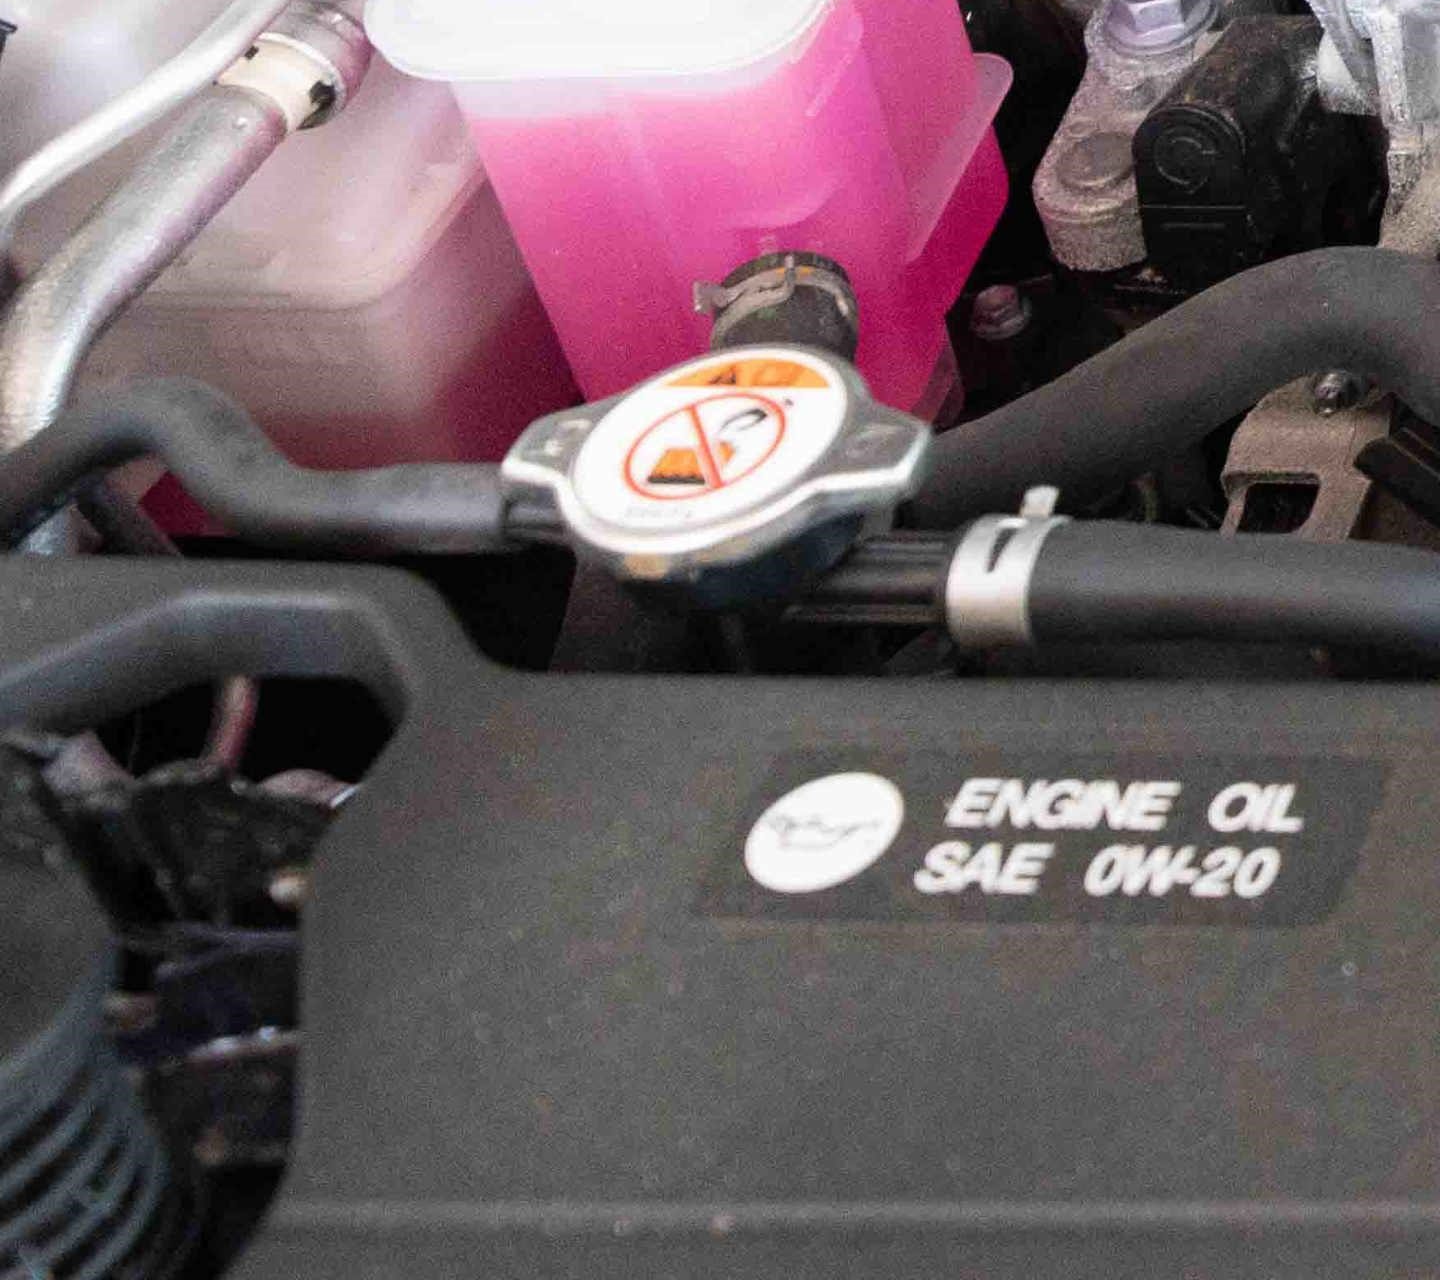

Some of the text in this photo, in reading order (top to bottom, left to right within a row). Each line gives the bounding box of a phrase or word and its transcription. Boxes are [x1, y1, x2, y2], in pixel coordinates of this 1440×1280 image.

[944, 777, 1306, 834] ENGINE OIL
[913, 841, 1055, 896] SAE
